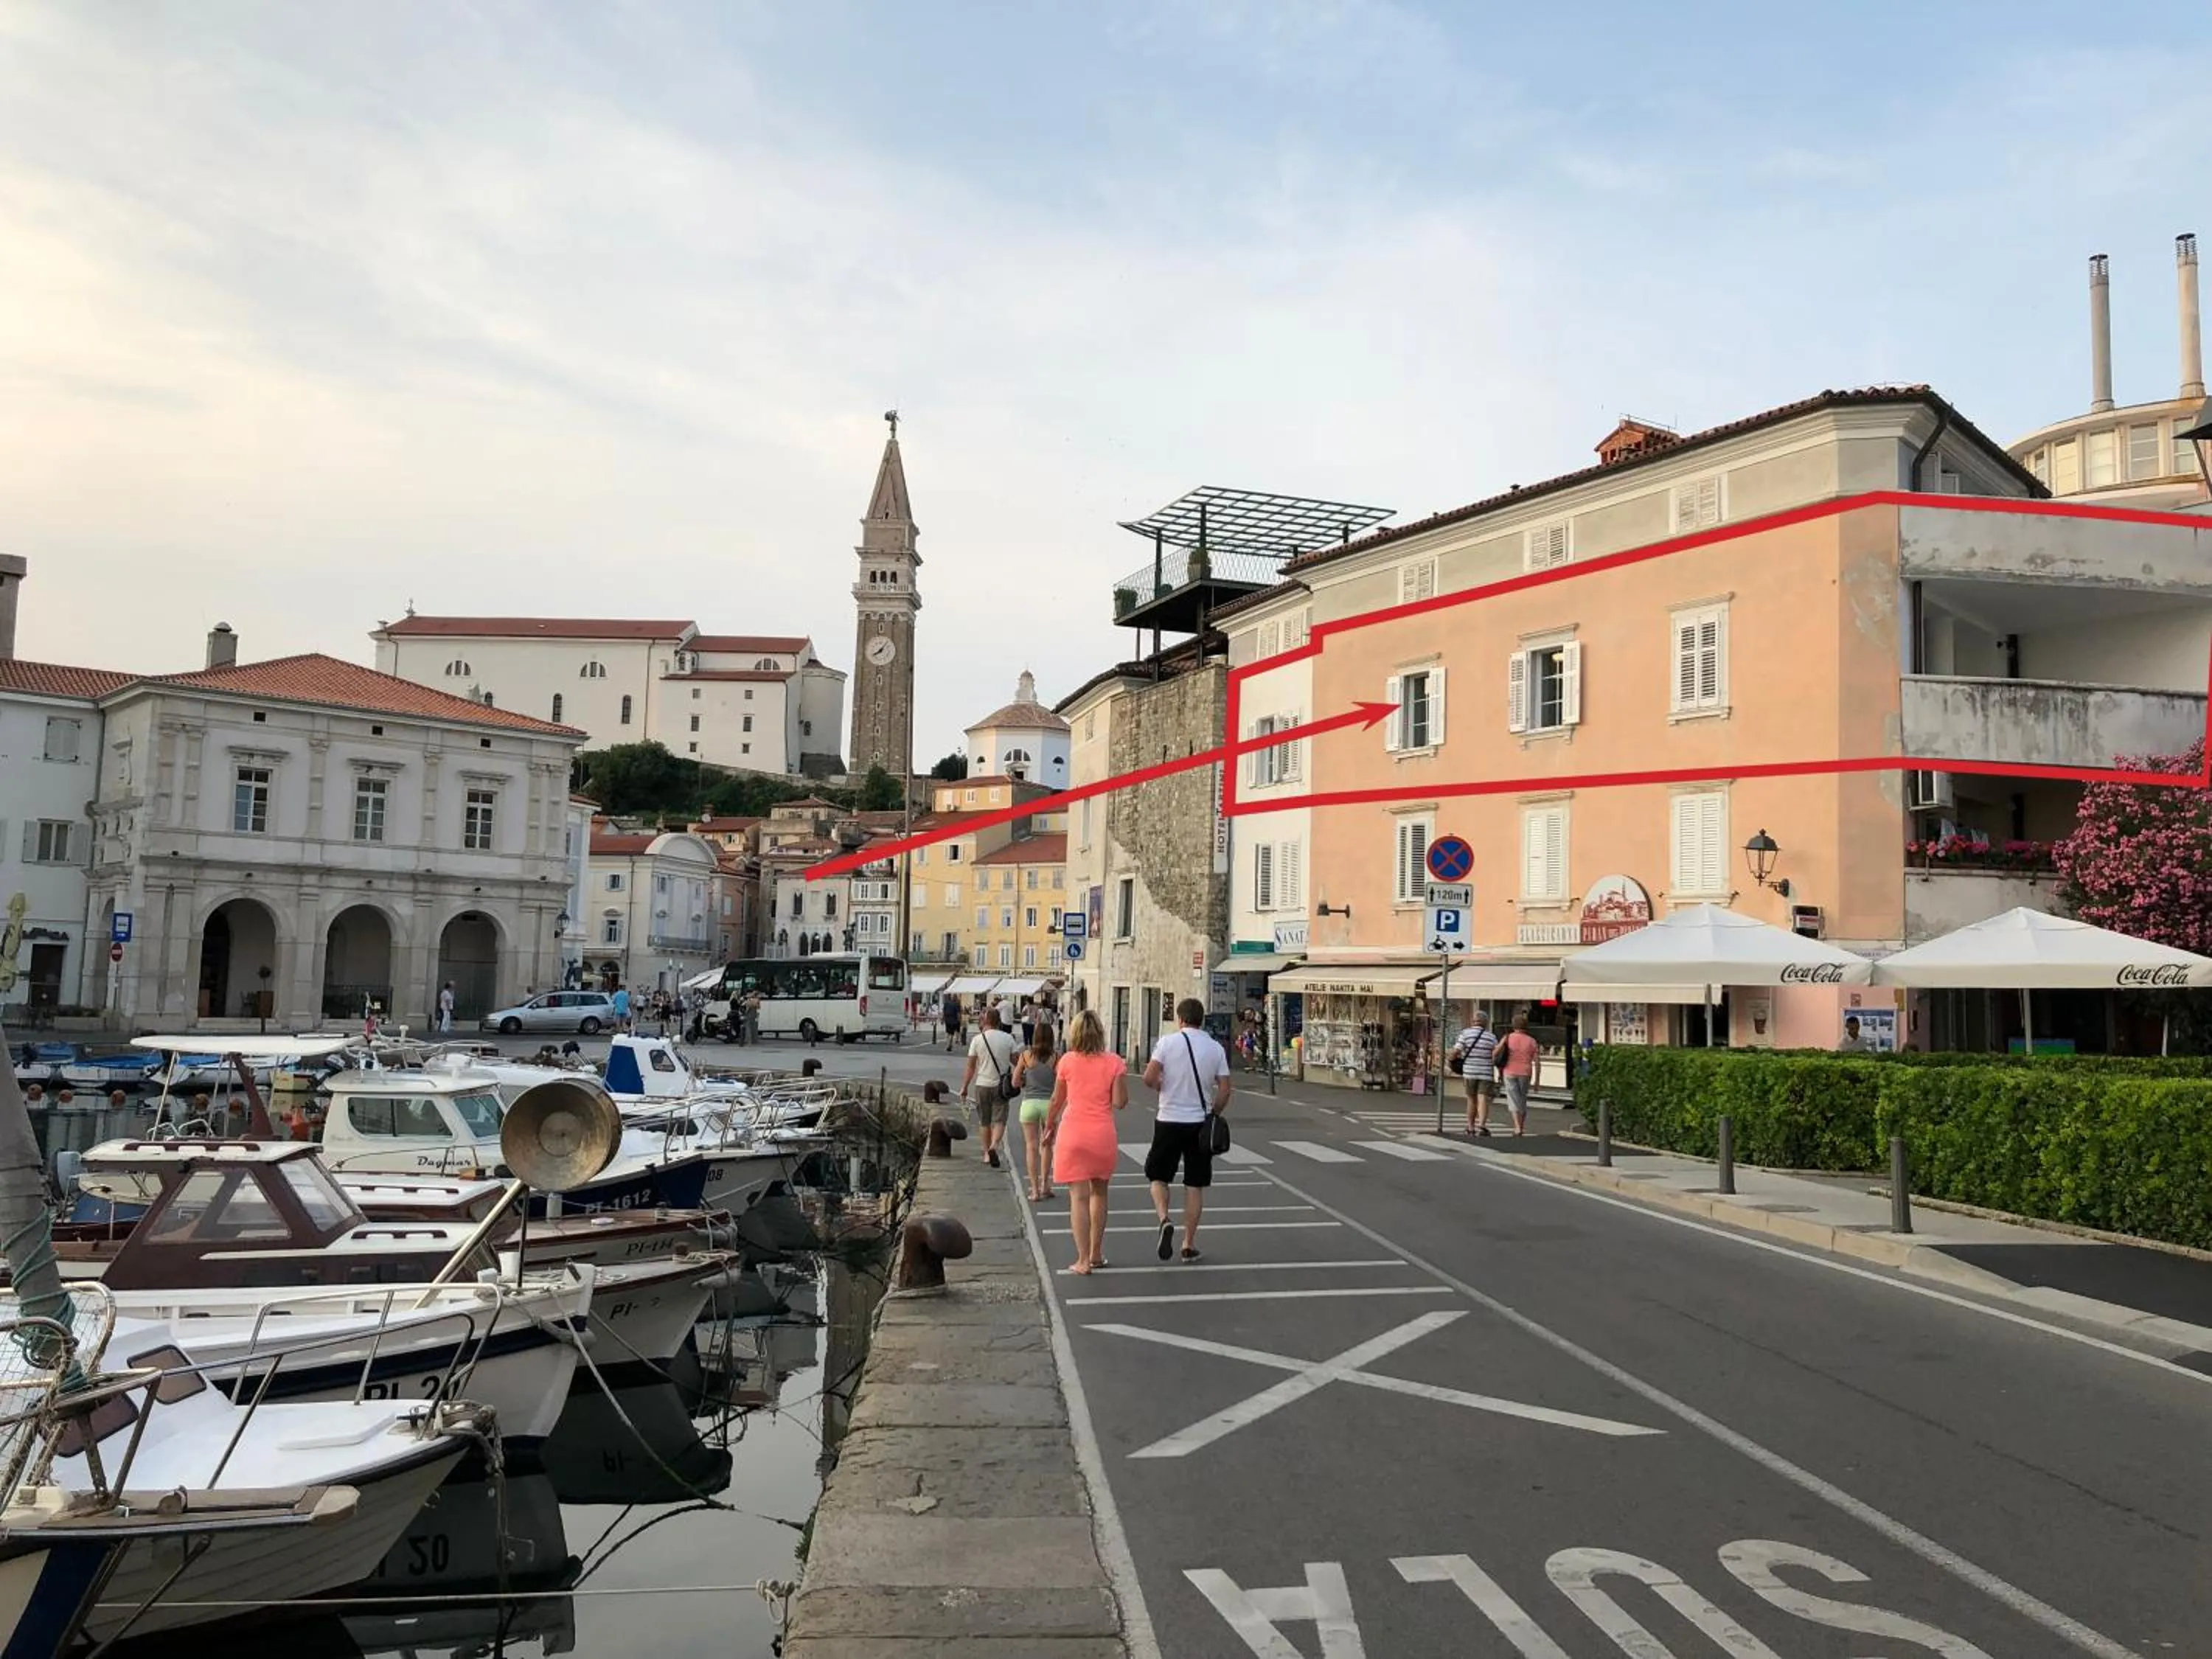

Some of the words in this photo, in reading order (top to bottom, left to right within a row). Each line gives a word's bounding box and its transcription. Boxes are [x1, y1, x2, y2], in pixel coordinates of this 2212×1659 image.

[1436, 889, 1463, 900] 120m
[1439, 911, 1455, 930] P
[1780, 961, 1847, 983] Coca-Cola
[2116, 963, 2193, 985] Coca-Cola
